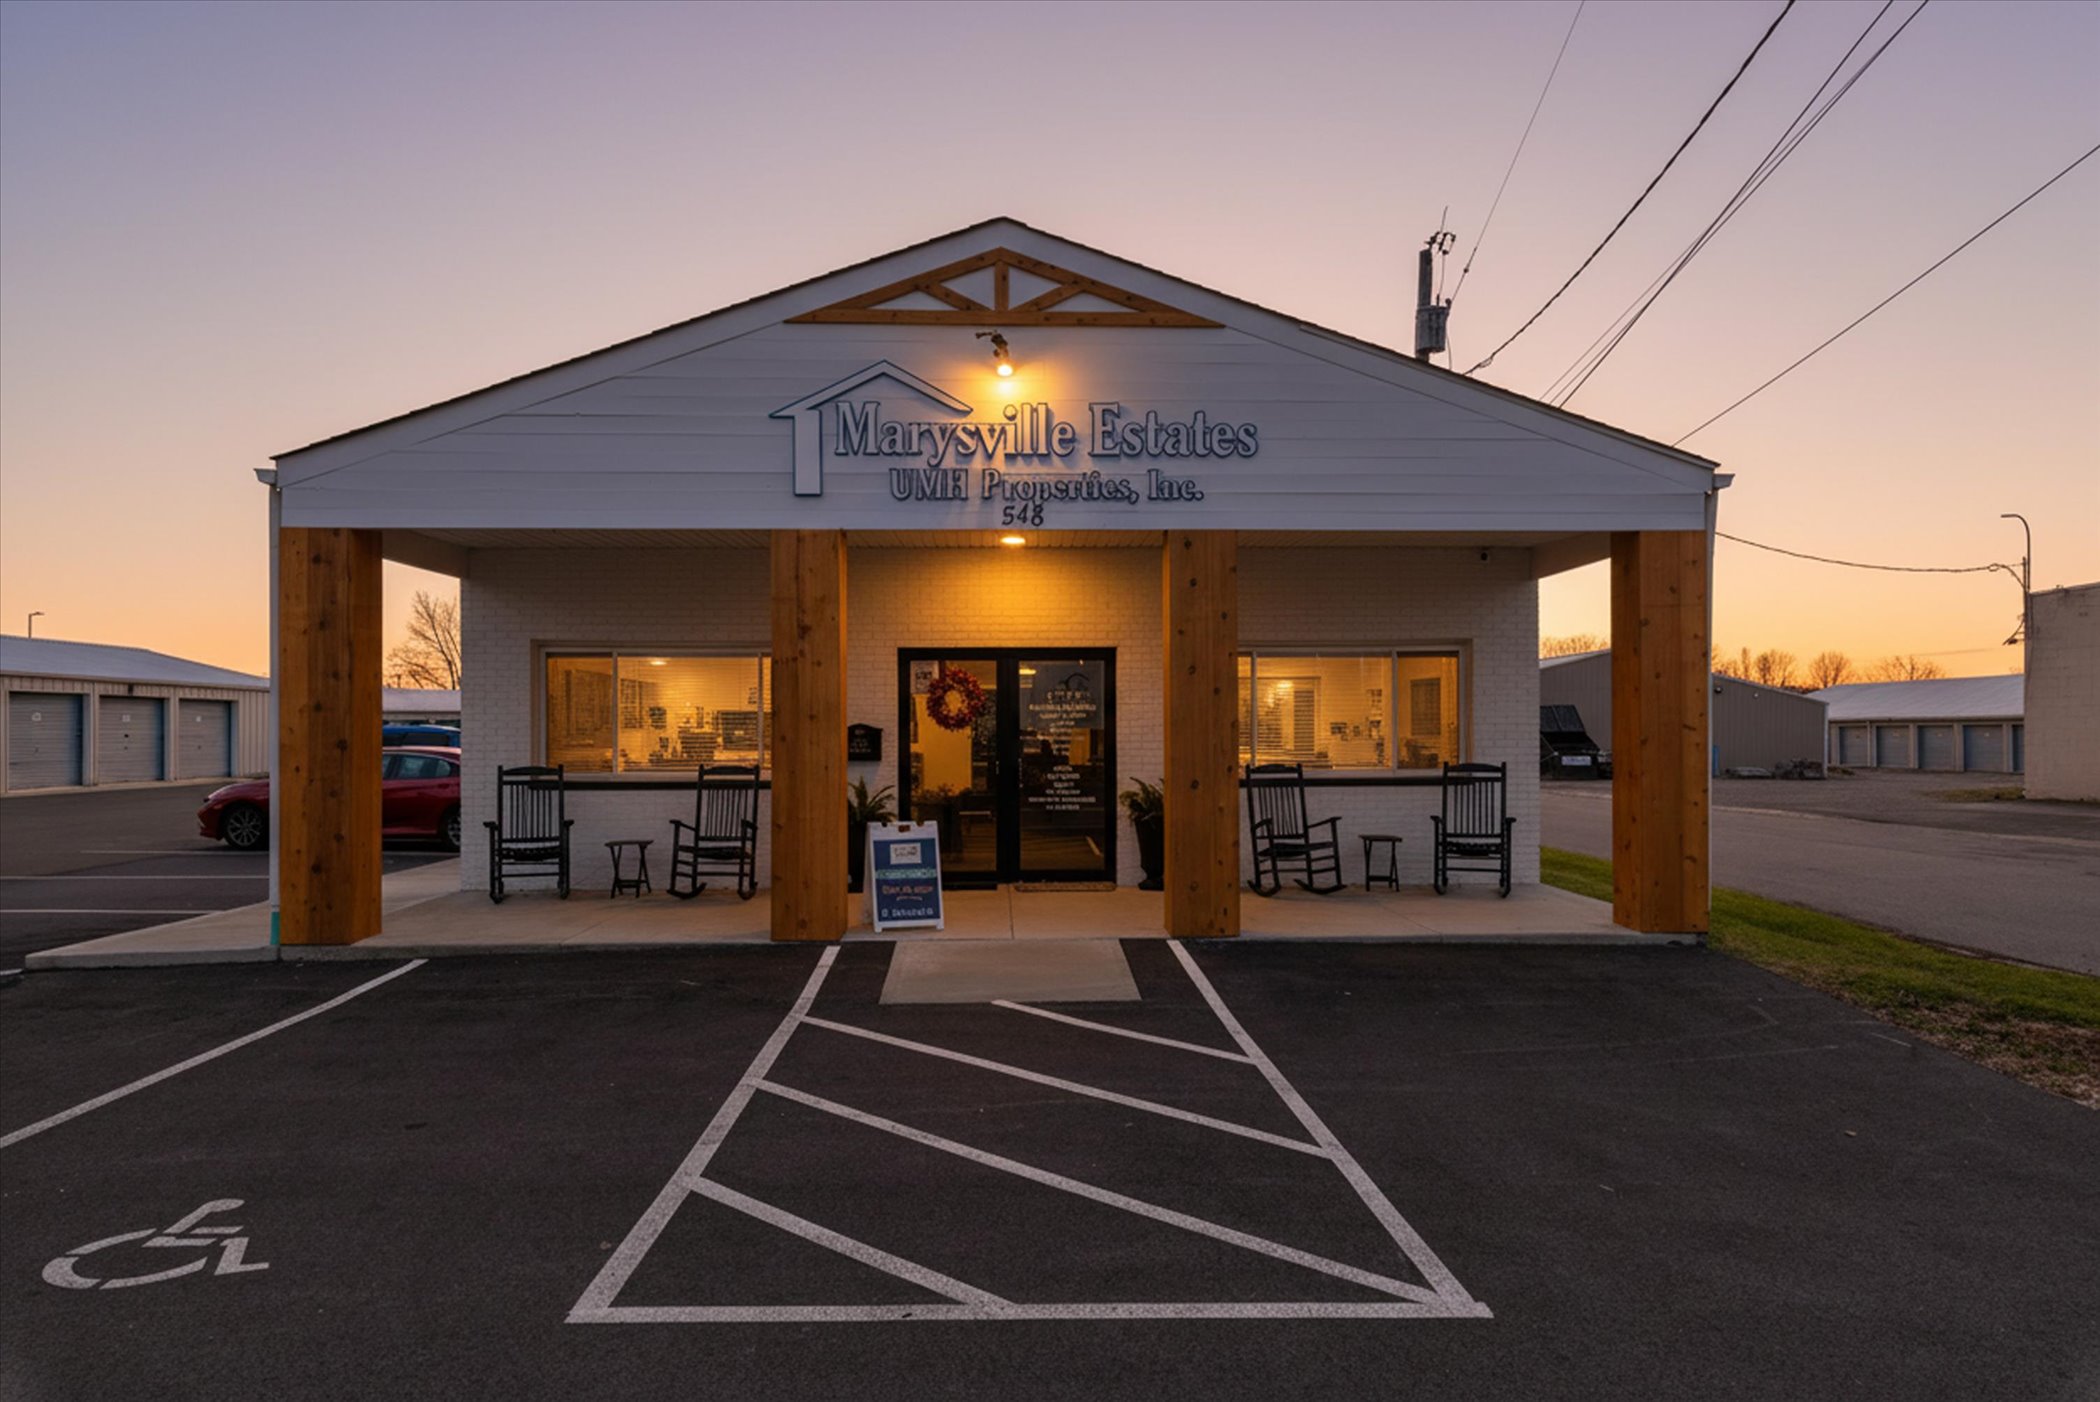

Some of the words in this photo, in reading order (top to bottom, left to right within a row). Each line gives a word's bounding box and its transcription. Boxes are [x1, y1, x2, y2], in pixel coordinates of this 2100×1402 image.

[834, 401, 1076, 467] Marysville
[1088, 401, 1259, 458] Estates
[889, 467, 968, 502] UMH
[1147, 468, 1204, 502] Inc.
[1002, 503, 1044, 527] 548
